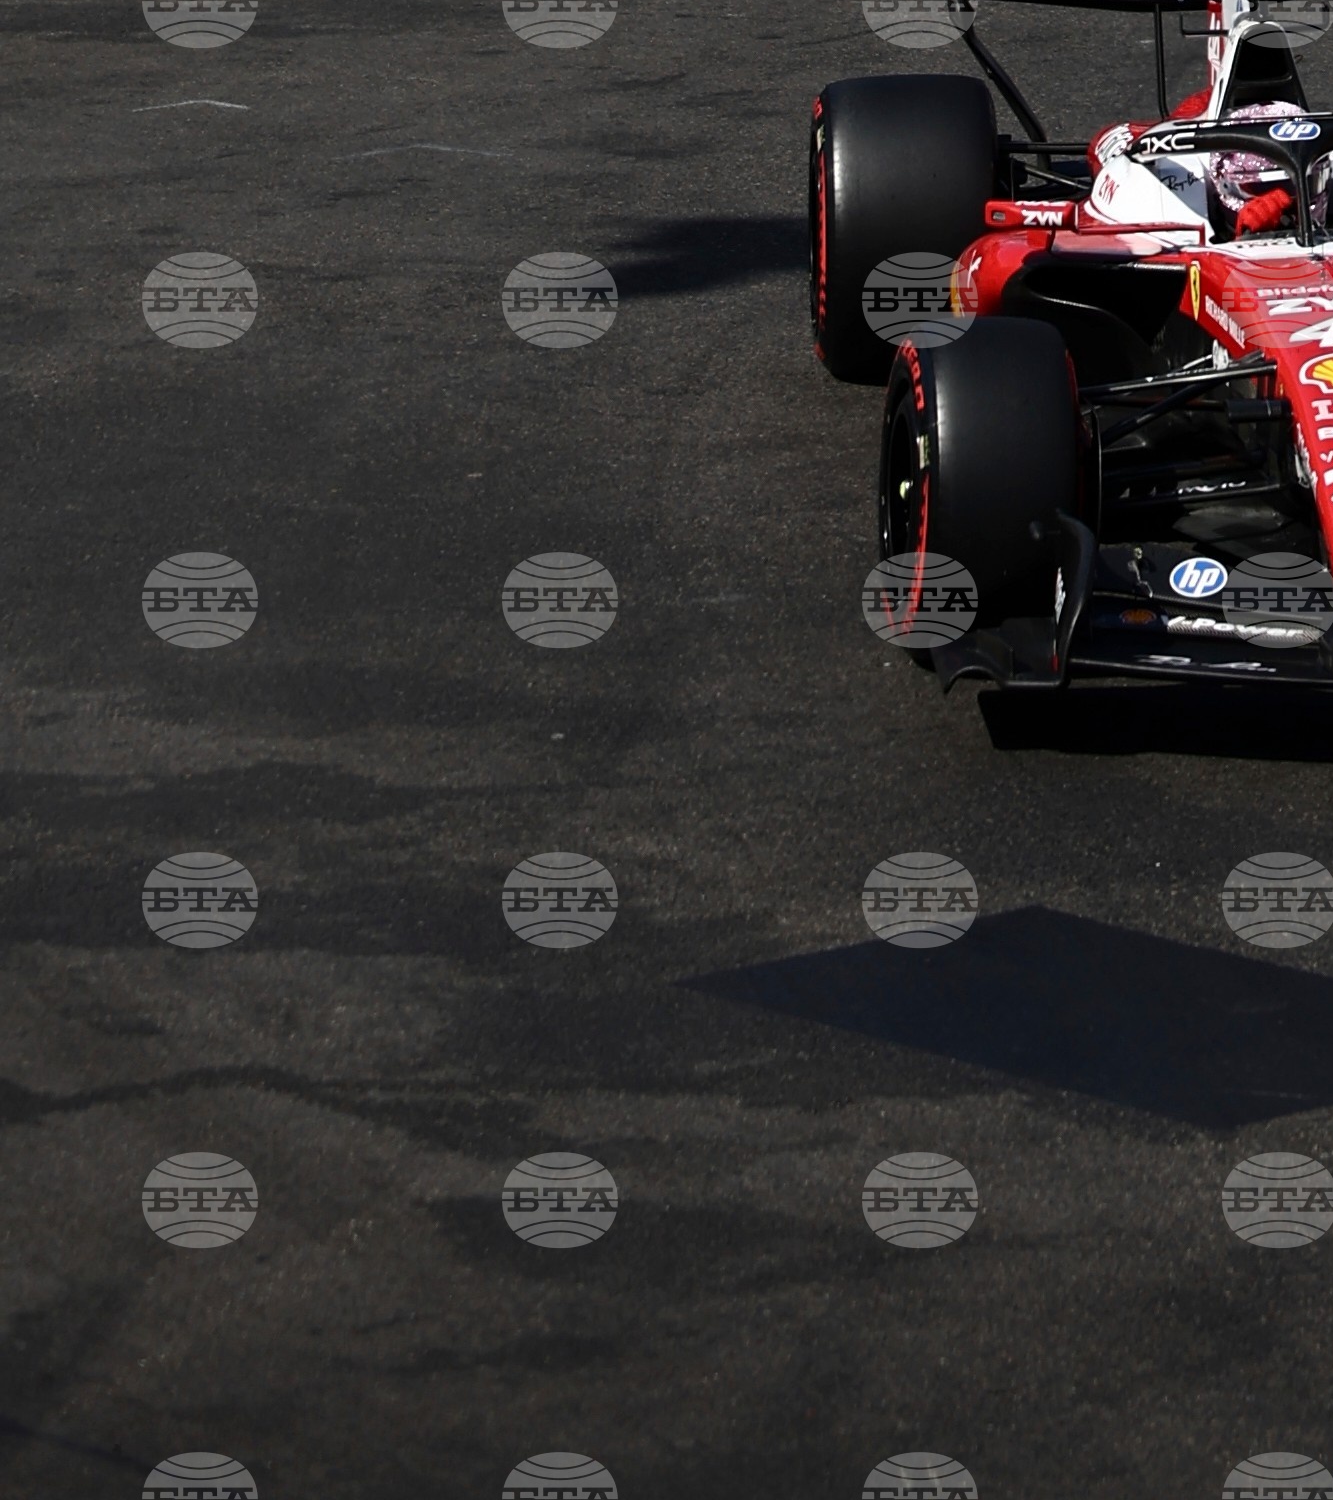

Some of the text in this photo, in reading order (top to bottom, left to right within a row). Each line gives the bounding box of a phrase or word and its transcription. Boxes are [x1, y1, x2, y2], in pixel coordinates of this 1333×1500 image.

[1277, 122, 1311, 140] hp
[1021, 209, 1064, 227] ZYN
[1179, 558, 1221, 597] hp
